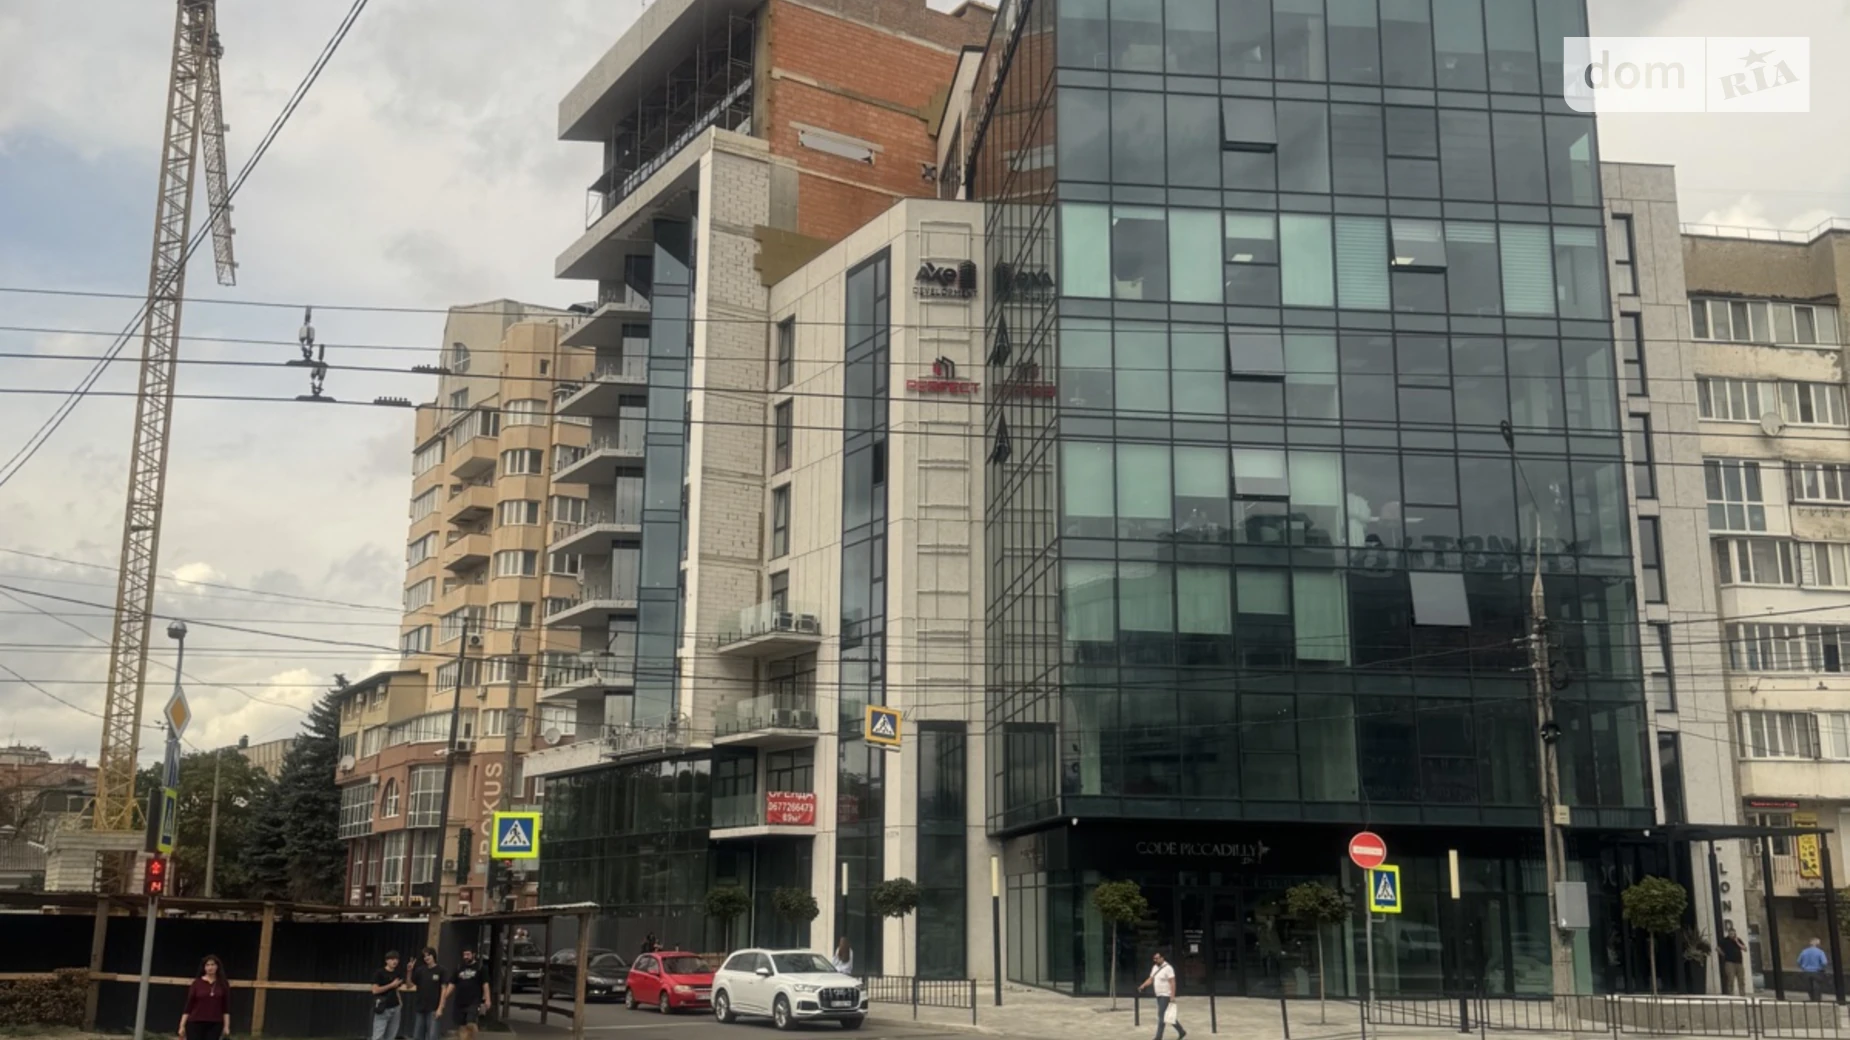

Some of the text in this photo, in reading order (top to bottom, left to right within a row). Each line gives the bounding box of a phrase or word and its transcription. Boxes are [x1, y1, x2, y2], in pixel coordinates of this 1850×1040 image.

[906, 379, 981, 394] PERFECT
[1135, 841, 1257, 857] CODE PICCADILLY
